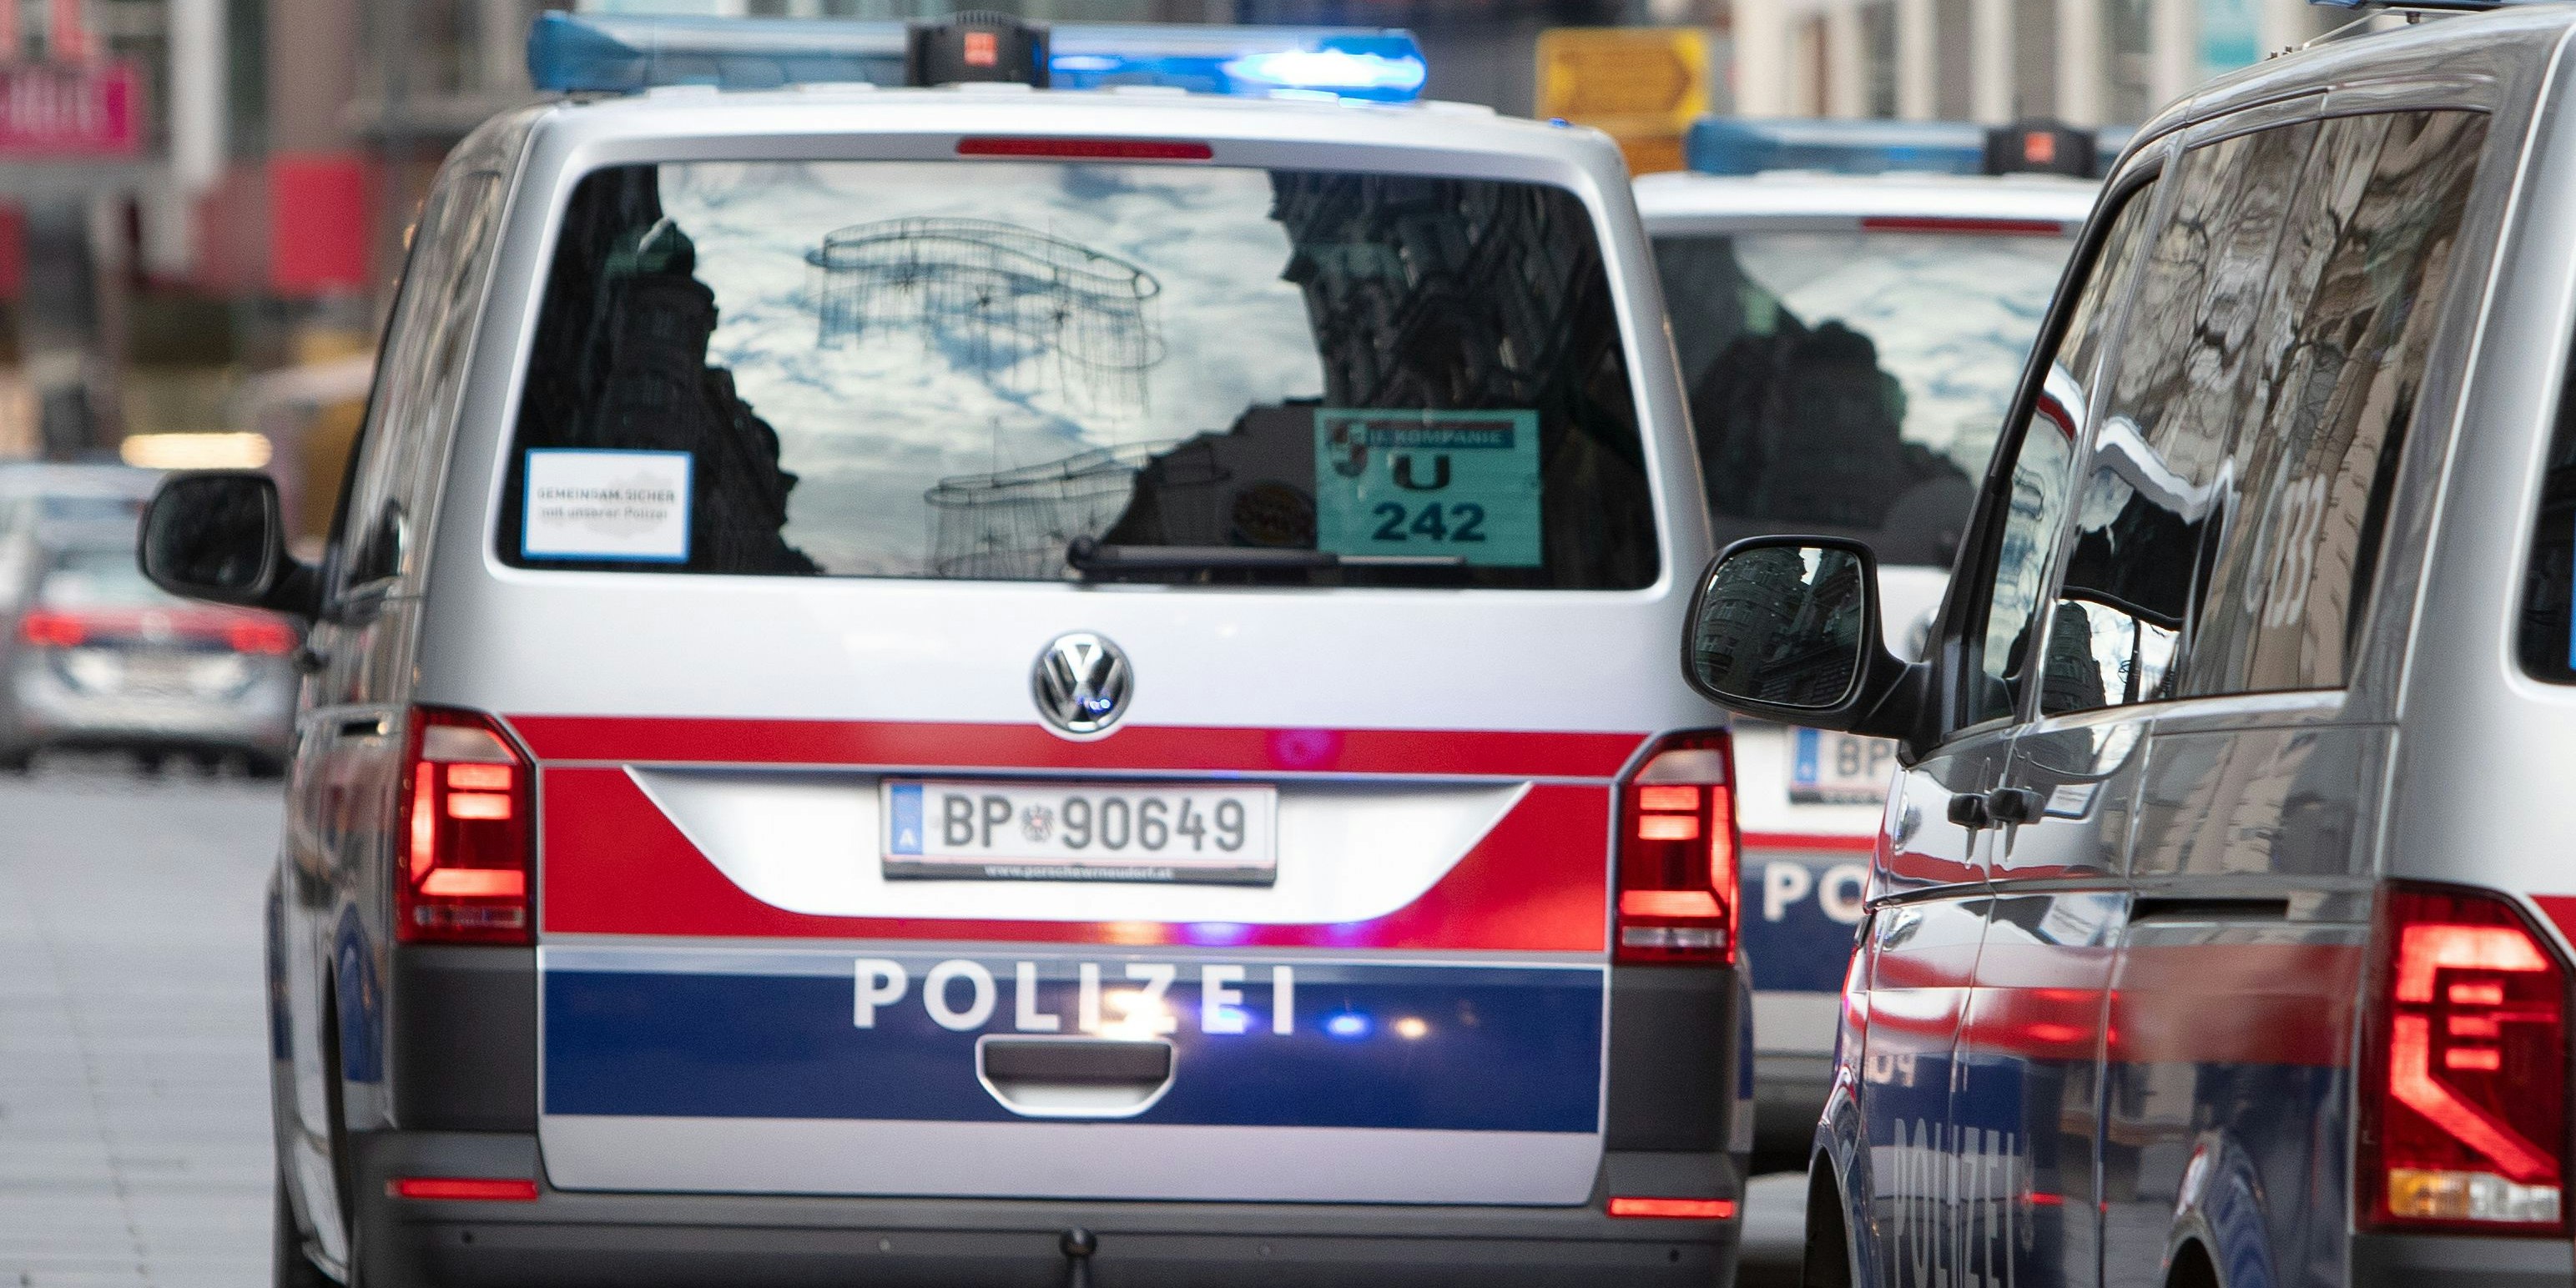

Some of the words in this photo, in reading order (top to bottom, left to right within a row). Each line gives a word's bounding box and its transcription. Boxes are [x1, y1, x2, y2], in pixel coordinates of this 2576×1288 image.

[1392, 453, 1451, 491] U
[623, 507, 668, 520] Polizei
[1371, 501, 1487, 542] 242
[1837, 736, 1892, 777] BP
[941, 792, 1012, 849] BP
[1061, 795, 1246, 853] 90649
[853, 957, 1293, 1036] POLIZEI
[1893, 1117, 2014, 1288] POLIZEI
